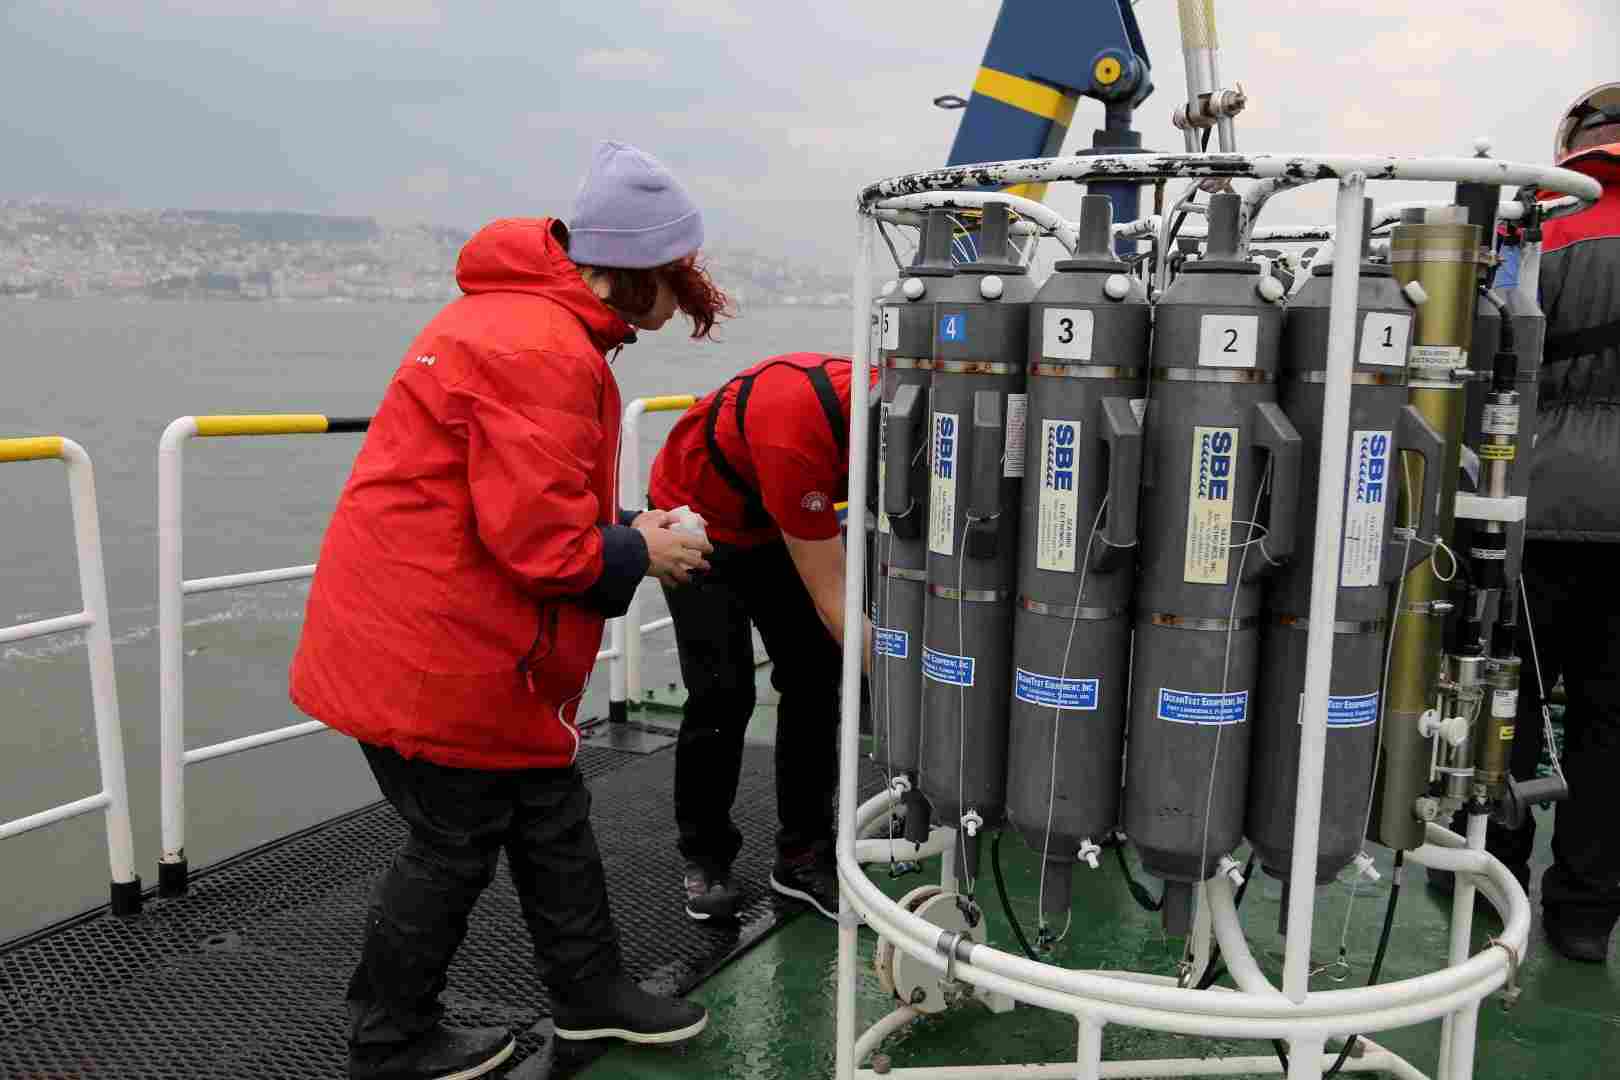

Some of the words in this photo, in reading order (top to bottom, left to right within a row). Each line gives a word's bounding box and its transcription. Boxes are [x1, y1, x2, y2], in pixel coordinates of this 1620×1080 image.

[946, 317, 957, 339] 4
[1057, 318, 1074, 344] 3
[1222, 329, 1238, 353] 2
[1382, 325, 1393, 348] 1
[939, 416, 955, 480] SBE
[1054, 424, 1074, 491] SBE
[1208, 431, 1233, 500] SBE
[1365, 434, 1387, 503] SBE
